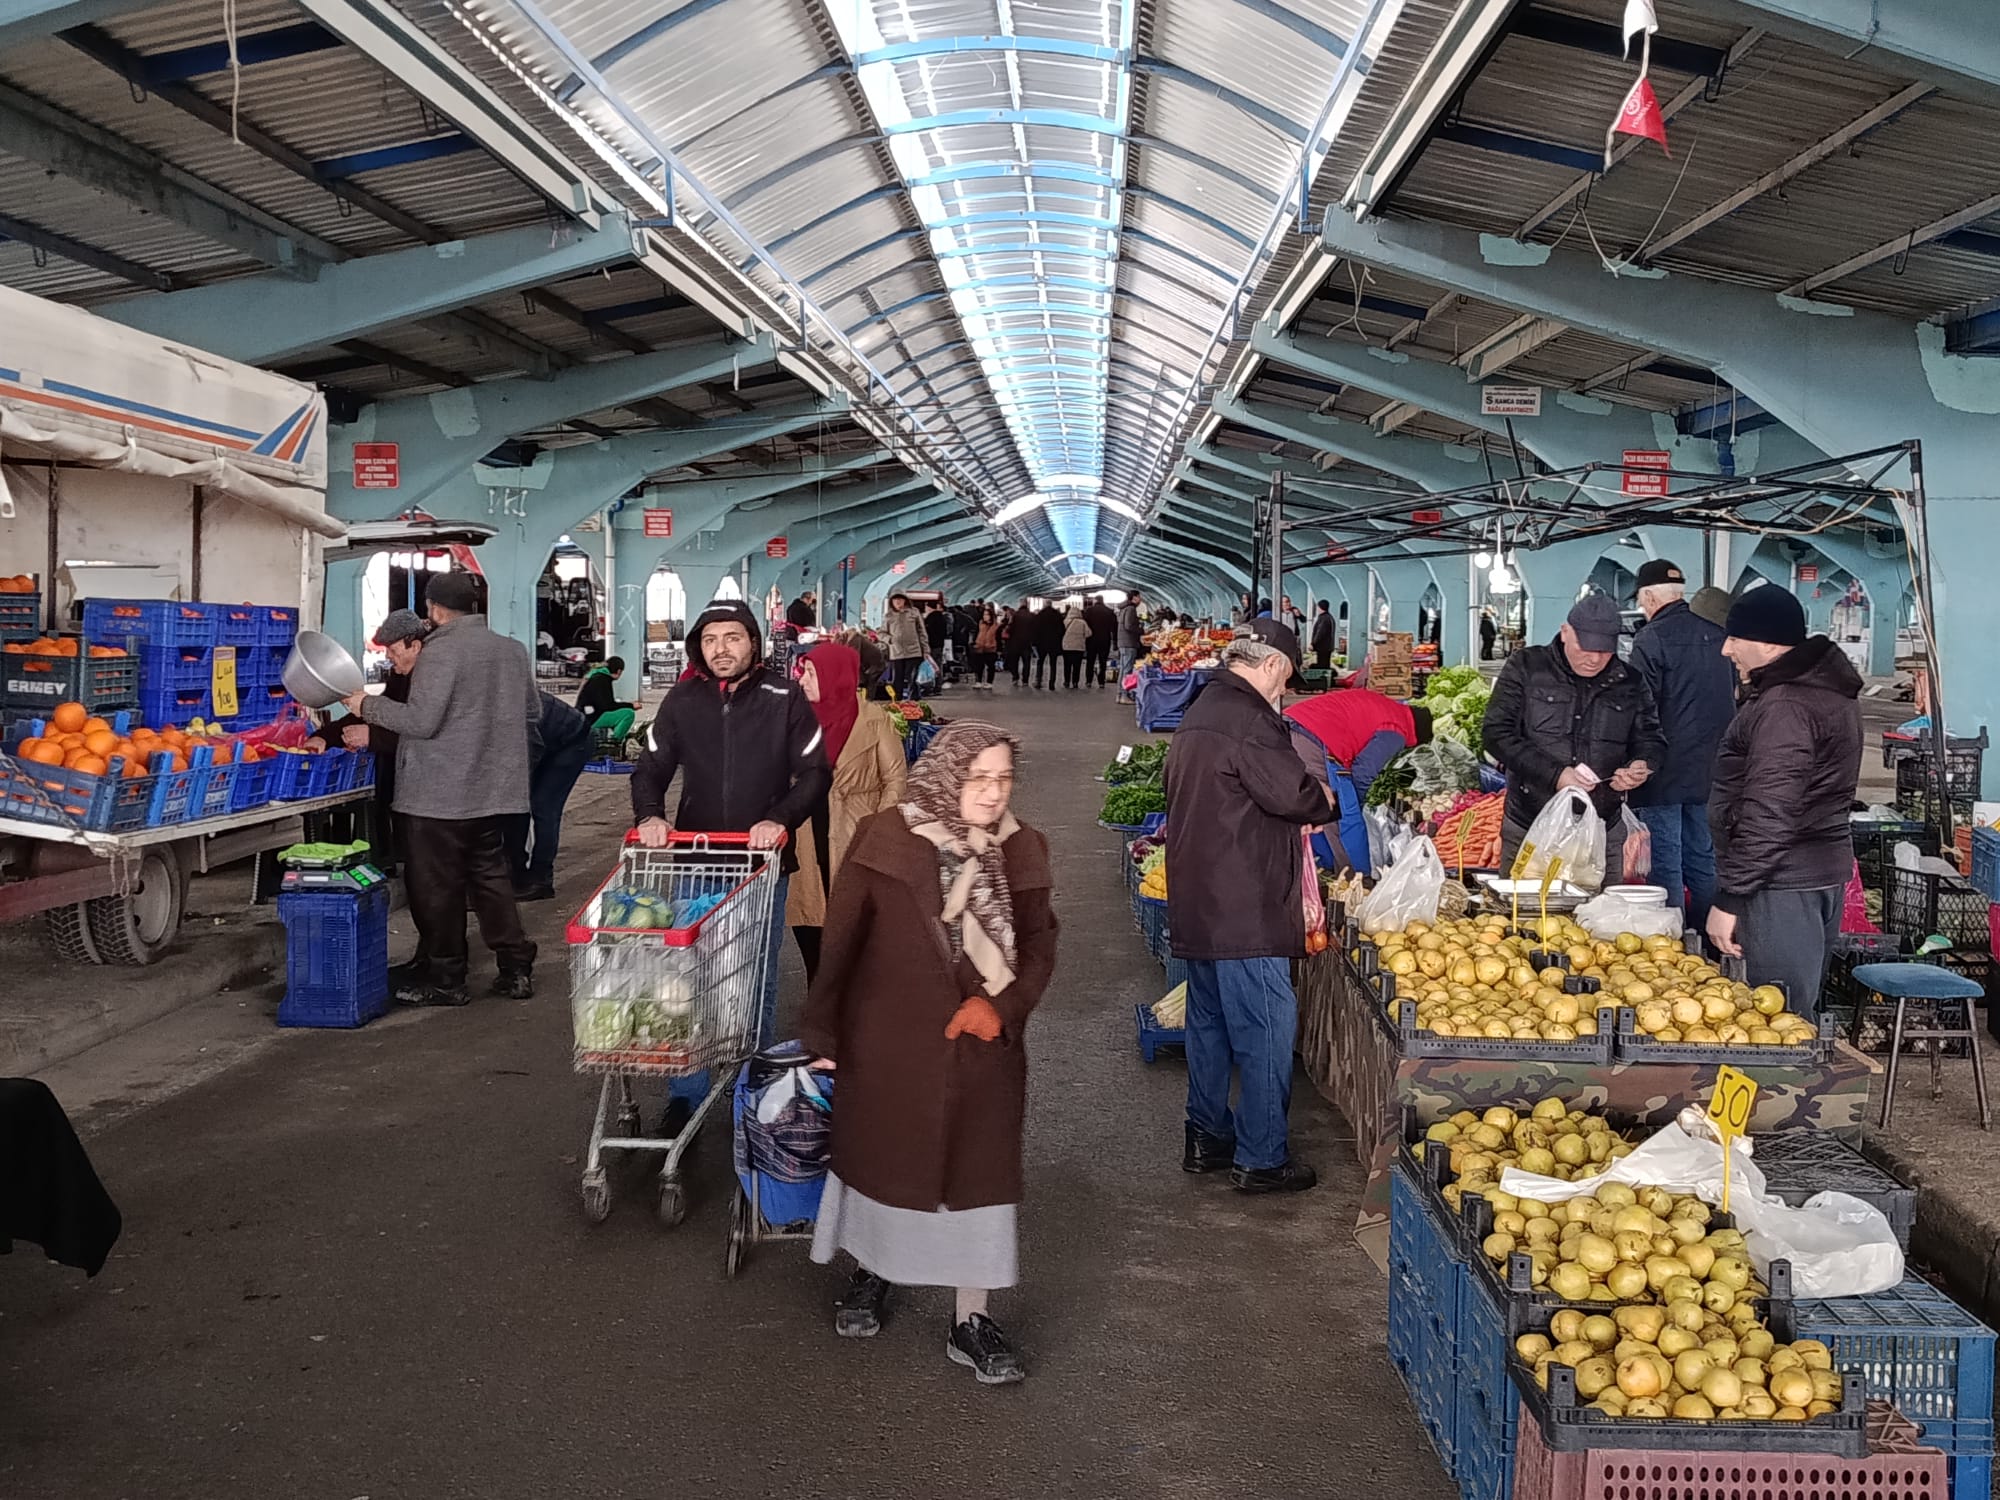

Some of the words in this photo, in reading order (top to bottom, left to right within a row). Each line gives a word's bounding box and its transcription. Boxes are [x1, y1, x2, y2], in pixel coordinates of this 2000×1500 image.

[1485, 396, 1494, 405] S
[7, 680, 67, 695] ERMEY
[1711, 1073, 1750, 1127] 50
